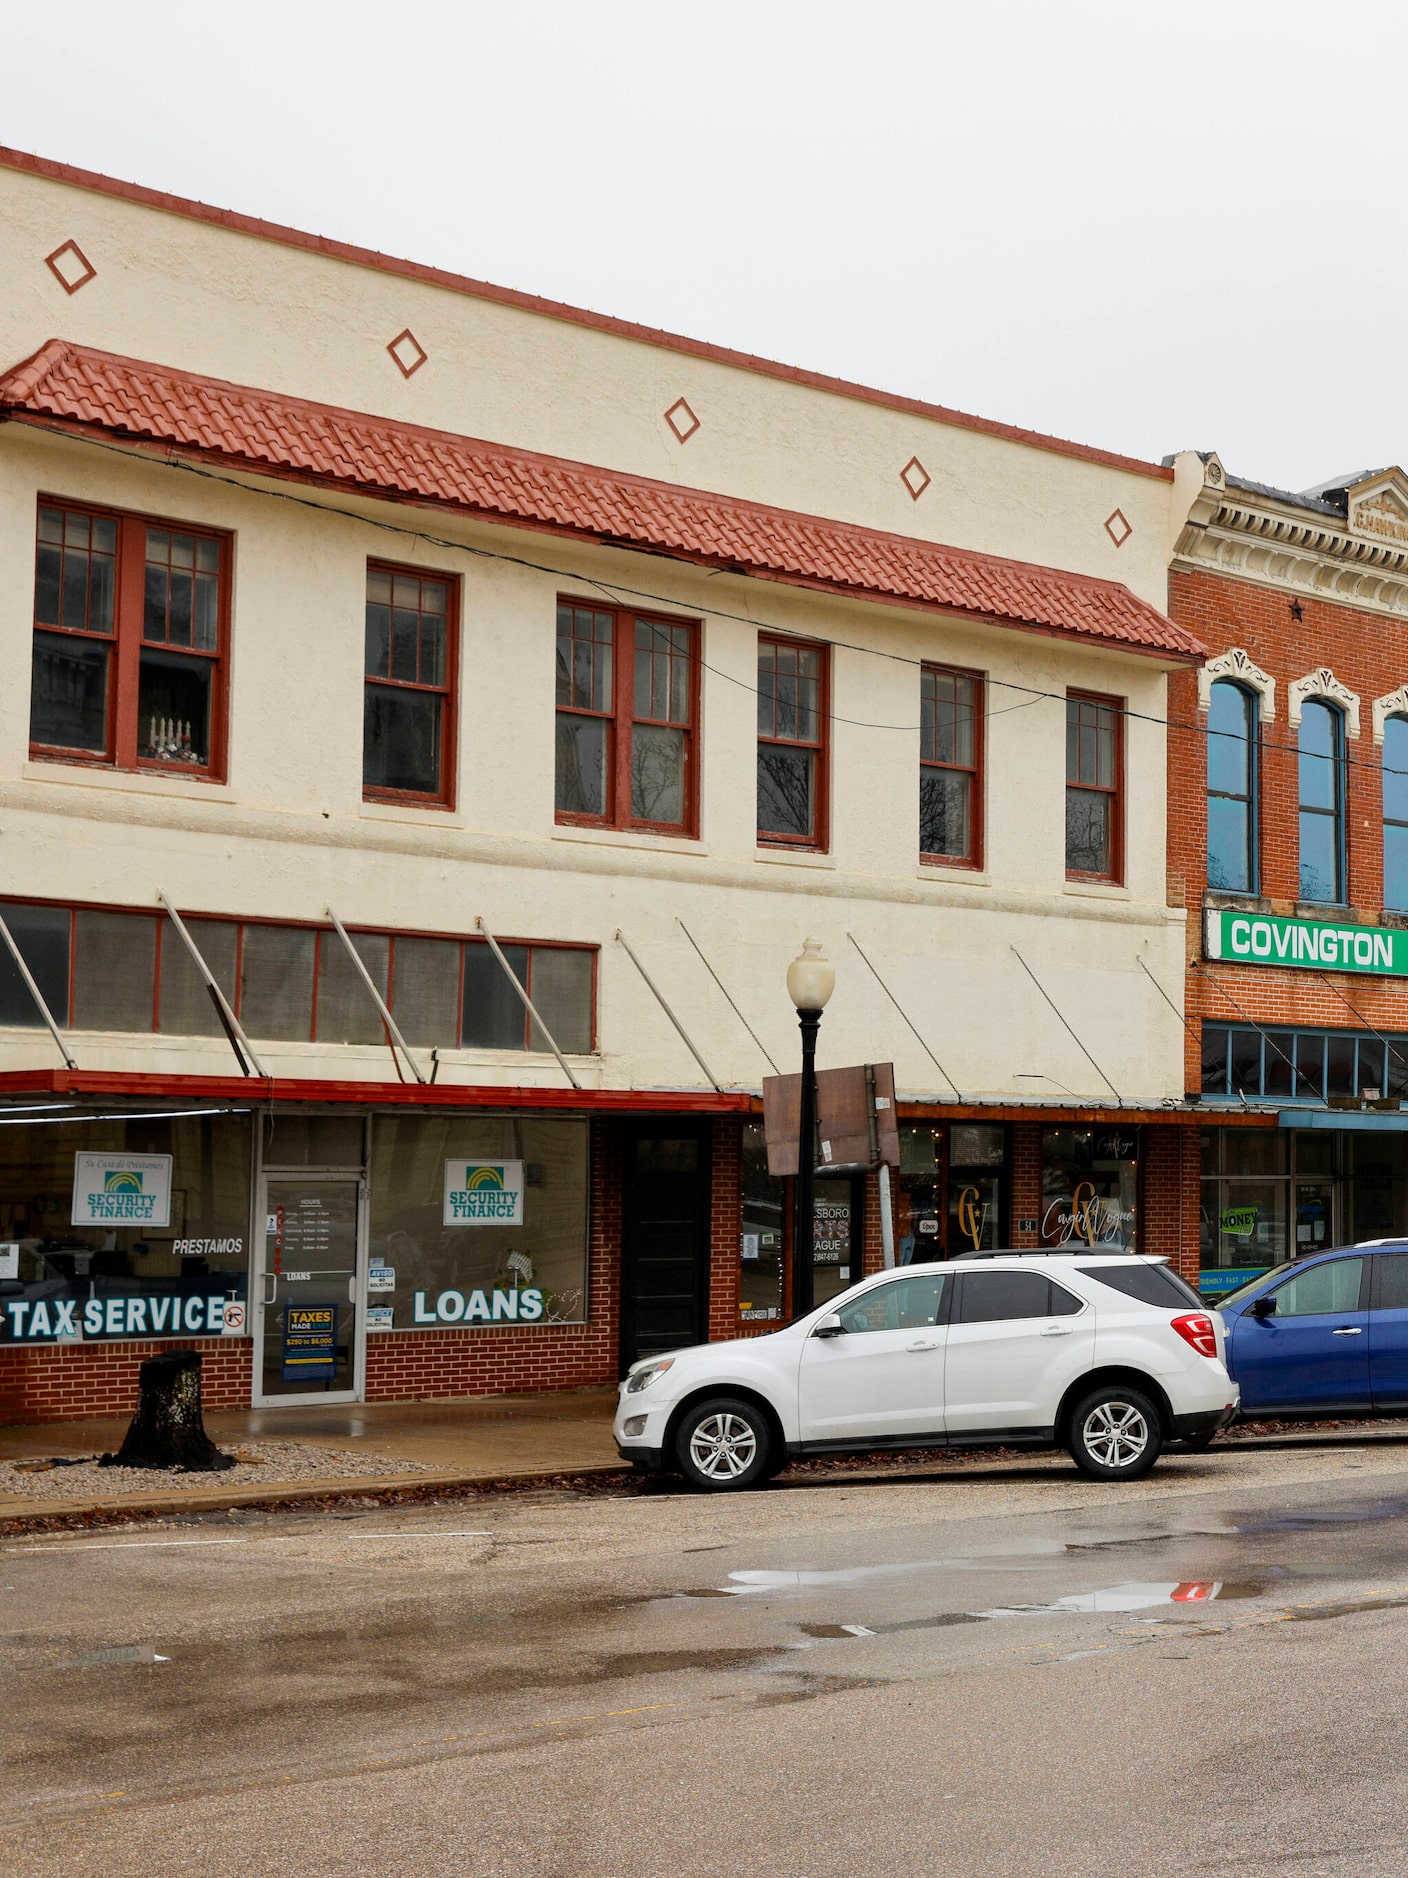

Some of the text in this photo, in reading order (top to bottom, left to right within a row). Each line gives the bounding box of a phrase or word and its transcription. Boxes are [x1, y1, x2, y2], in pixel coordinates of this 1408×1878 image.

[1231, 919, 1392, 968] COVINGTON
[87, 1193, 157, 1207] SECURITY
[450, 1191, 518, 1205] SECURITY
[90, 1205, 153, 1219] FINANCE
[453, 1205, 515, 1218] FINANCE
[813, 1208, 849, 1219] SBORO
[1220, 1211, 1258, 1228] MONEY
[172, 1238, 243, 1254] PRESTAMOS
[286, 1271, 311, 1281] LOANS
[371, 1270, 393, 1278] AVISO
[1200, 1276, 1223, 1285] RIENDLY
[414, 1288, 543, 1323] LOANS
[8, 1296, 225, 1337] TAX SERVICE
[291, 1312, 331, 1323] TAXES
